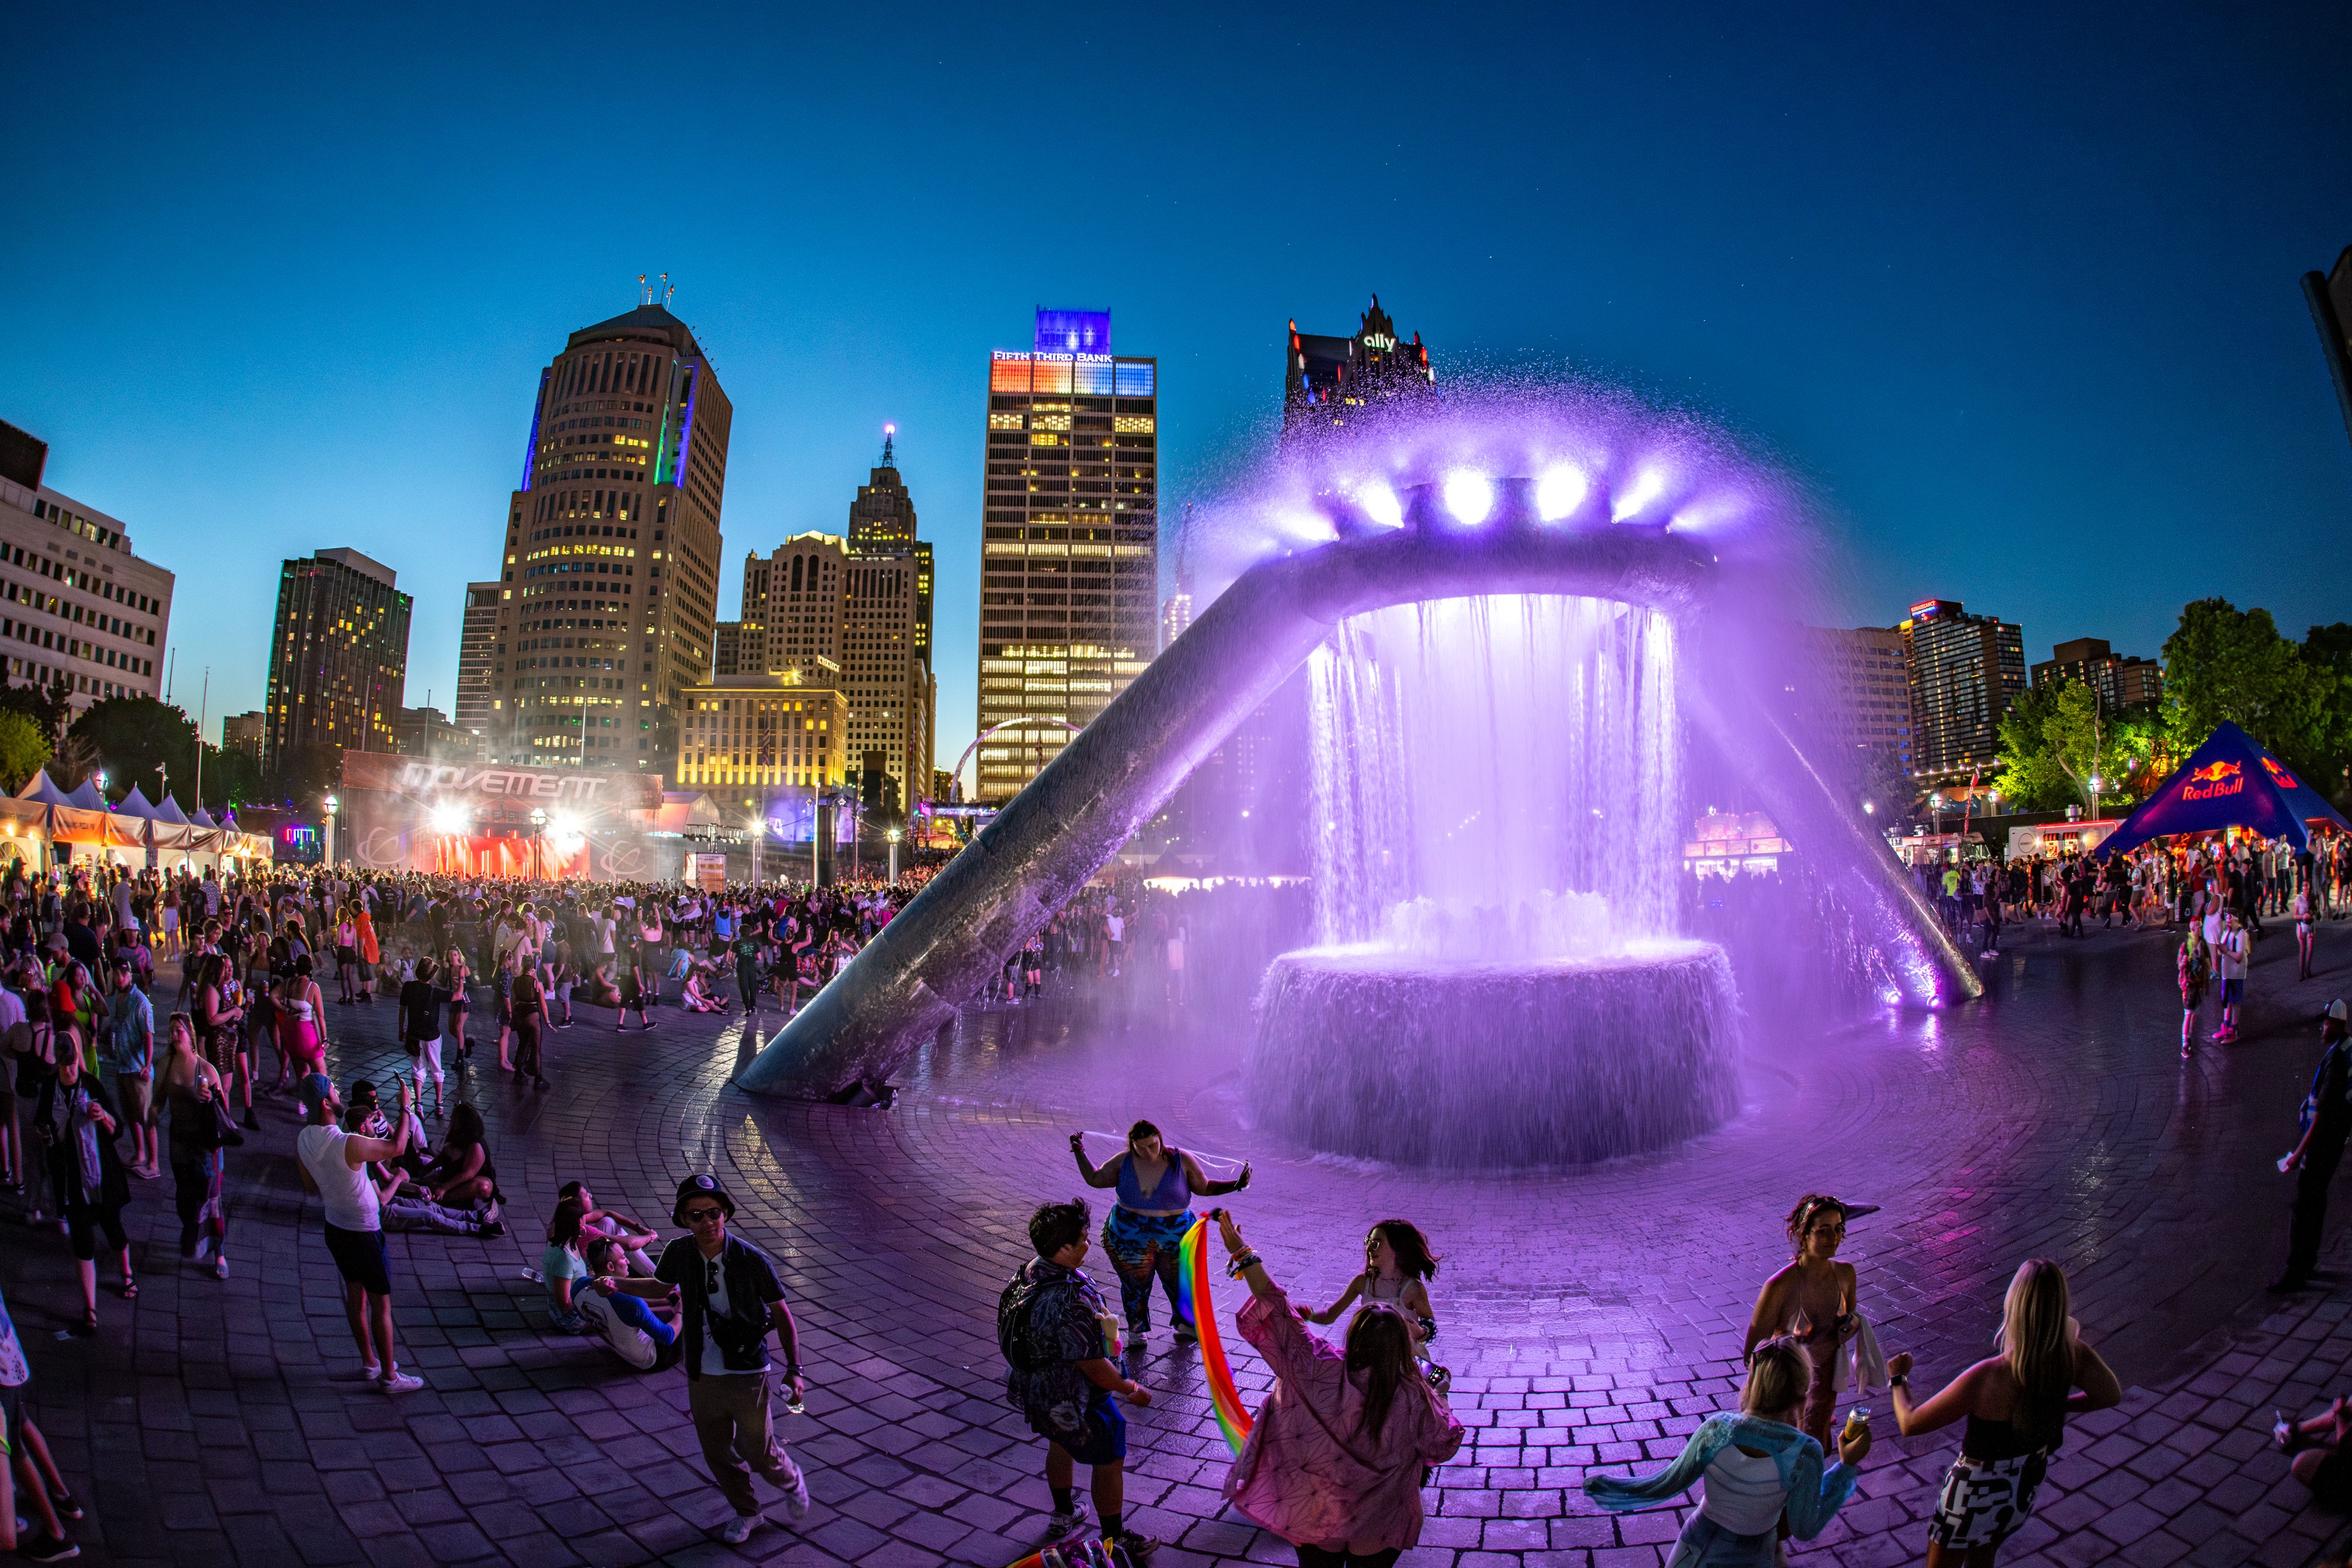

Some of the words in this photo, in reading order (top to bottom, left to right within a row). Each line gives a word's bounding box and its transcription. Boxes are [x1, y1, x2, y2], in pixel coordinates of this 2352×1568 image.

[1364, 333, 1395, 352] ally
[994, 351, 1030, 360] FIFTH
[1034, 352, 1073, 362] THIRD
[1077, 353, 1113, 362] BANK
[1910, 600, 1936, 613] RENAISSANCE
[402, 763, 607, 799] MOVEMENT
[2182, 783, 2214, 800] Red
[2214, 777, 2244, 797] Bull
